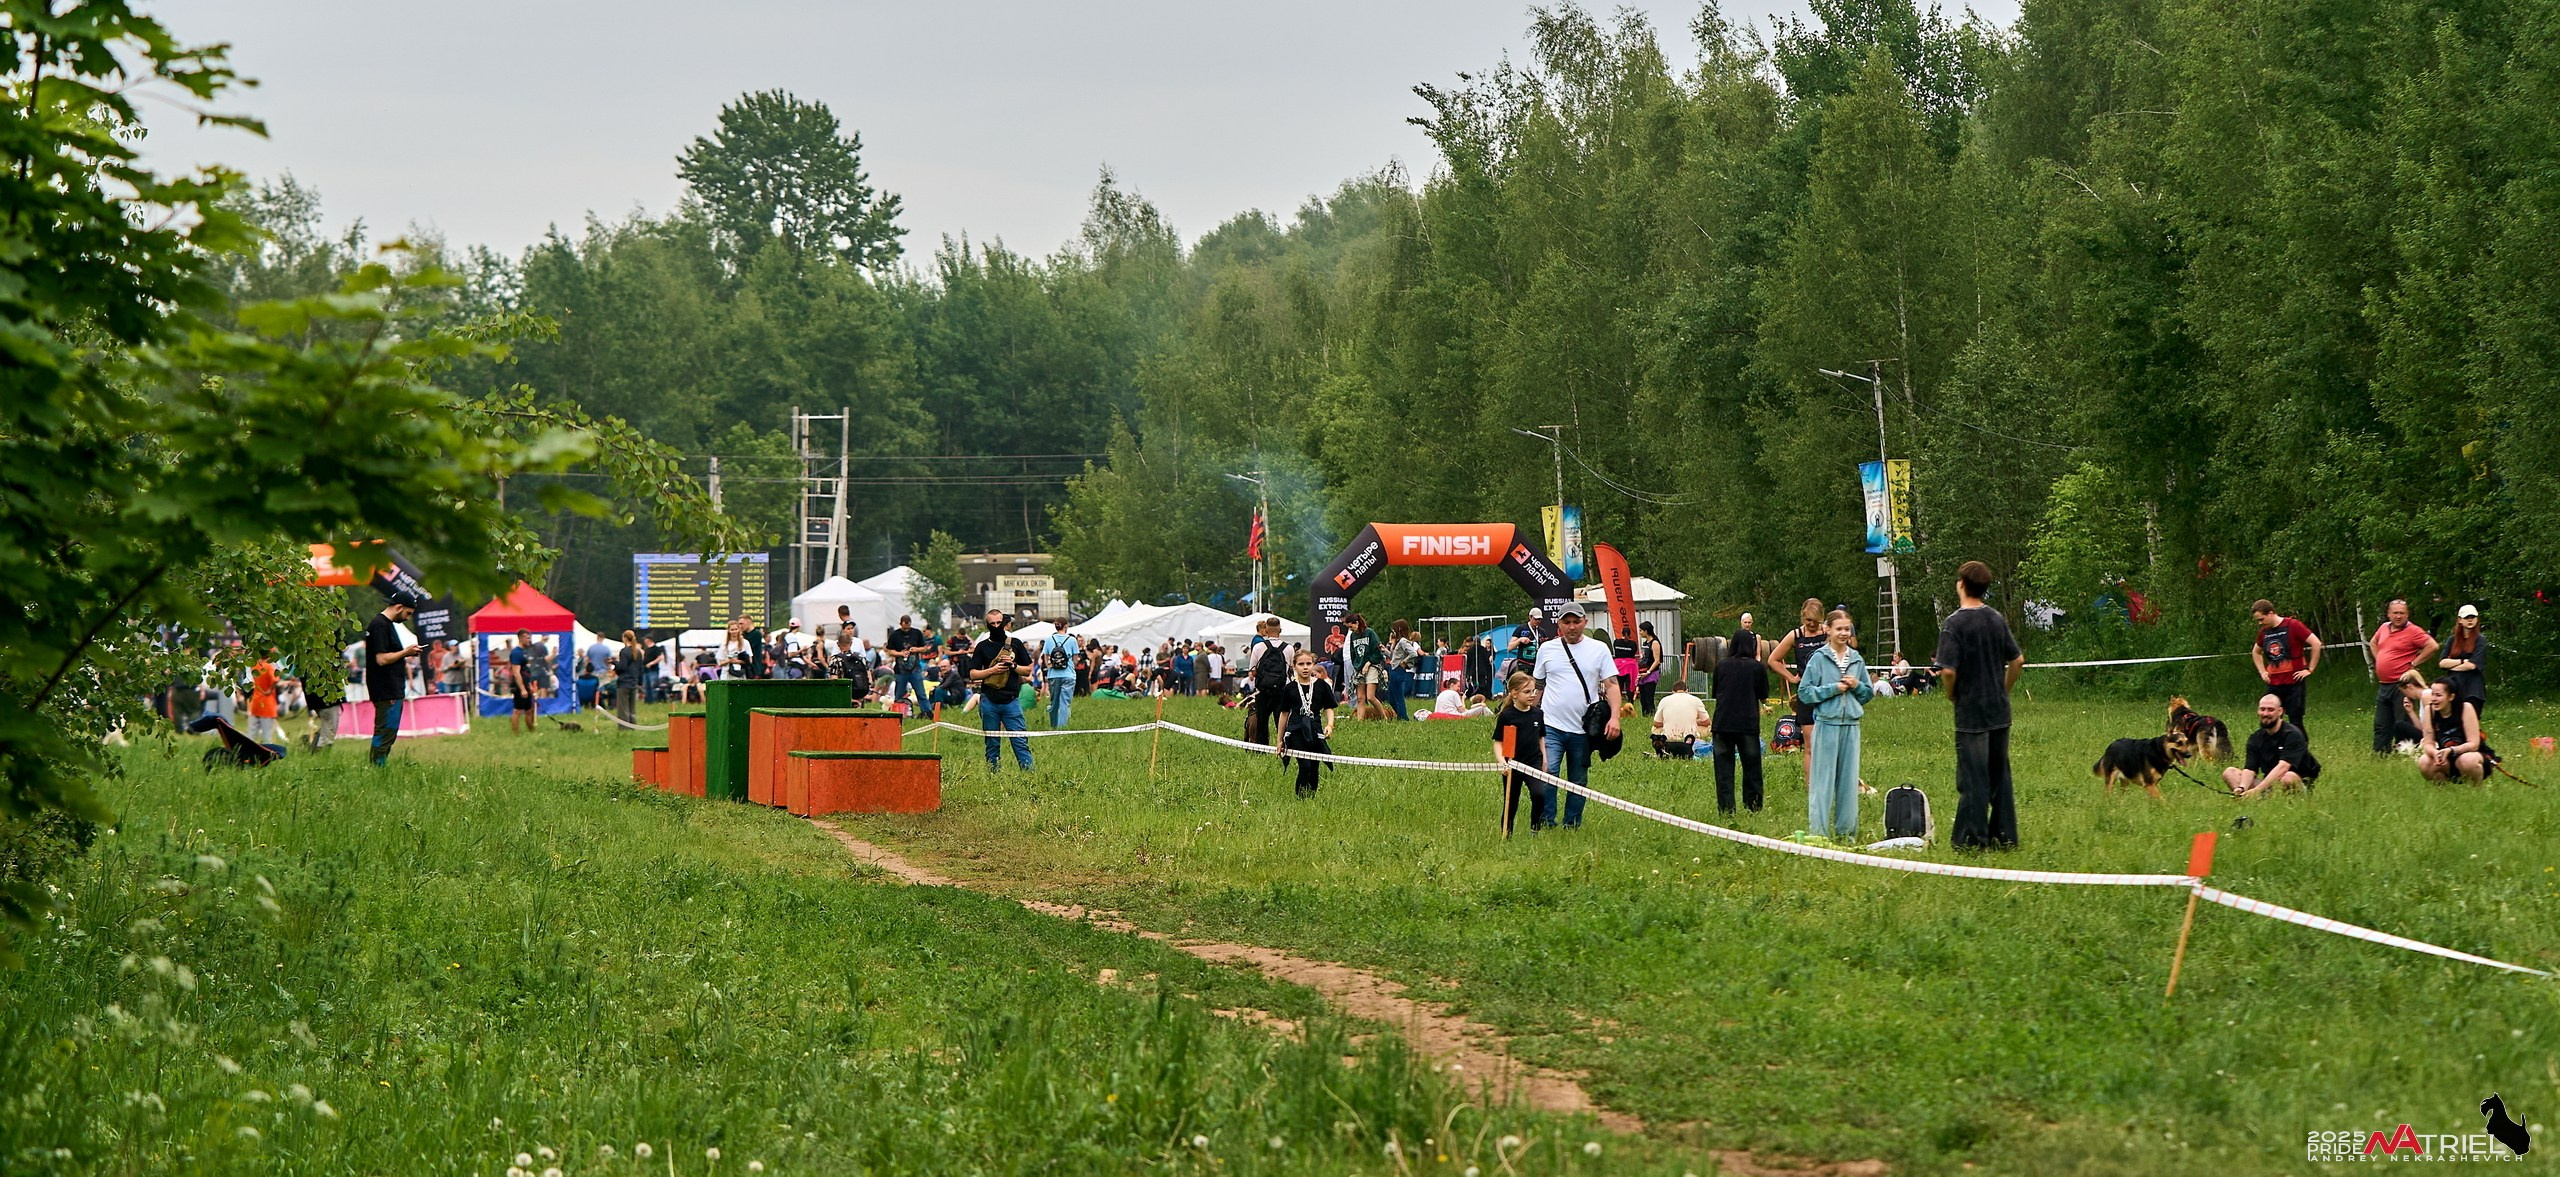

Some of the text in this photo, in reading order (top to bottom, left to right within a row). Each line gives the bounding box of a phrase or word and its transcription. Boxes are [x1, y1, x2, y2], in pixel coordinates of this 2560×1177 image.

[1347, 541, 1379, 571] четыре
[1403, 535, 1490, 556] FINISH
[1354, 555, 1378, 579] лапы
[1523, 562, 1547, 586] лапы
[1530, 556, 1560, 586] четыре
[1610, 567, 1625, 604] лапы
